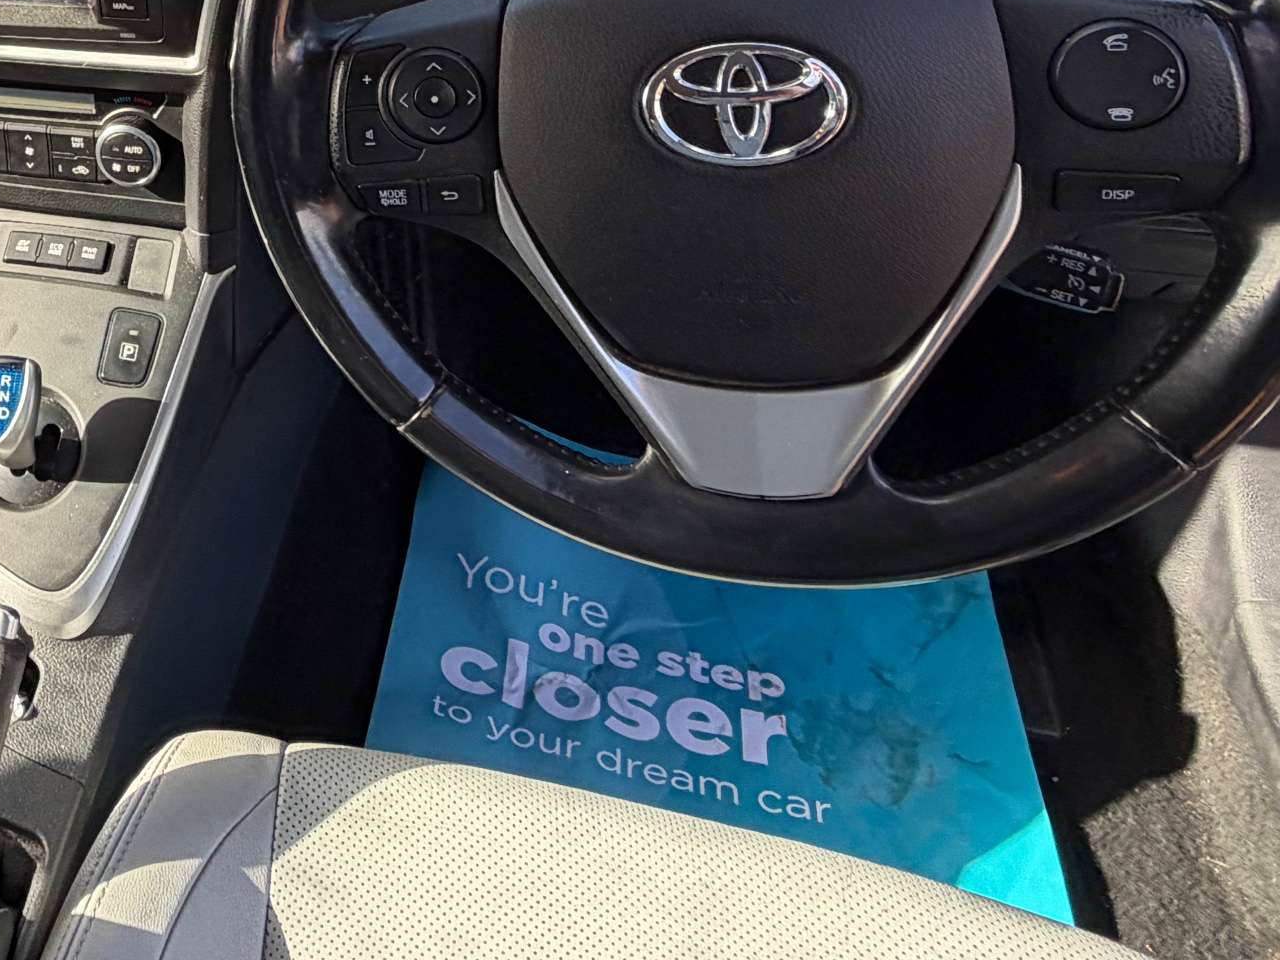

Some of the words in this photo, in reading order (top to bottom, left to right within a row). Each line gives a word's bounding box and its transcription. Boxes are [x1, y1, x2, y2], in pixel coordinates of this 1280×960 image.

[124, 145, 143, 154] AUTO
[127, 165, 140, 173] OFF
[379, 189, 407, 199] MODE
[1101, 189, 1135, 200] DISP
[49, 242, 64, 250] ECO
[1060, 257, 1087, 272] RES
[1050, 288, 1074, 303] SET
[0, 374, 12, 386] R
[0, 390, 10, 402] N
[537, 622, 640, 670] one
[656, 650, 786, 702] step
[439, 638, 788, 766] closer
[432, 693, 472, 724] to
[486, 713, 581, 761] your
[595, 747, 739, 805] dream
[757, 787, 832, 824] car
